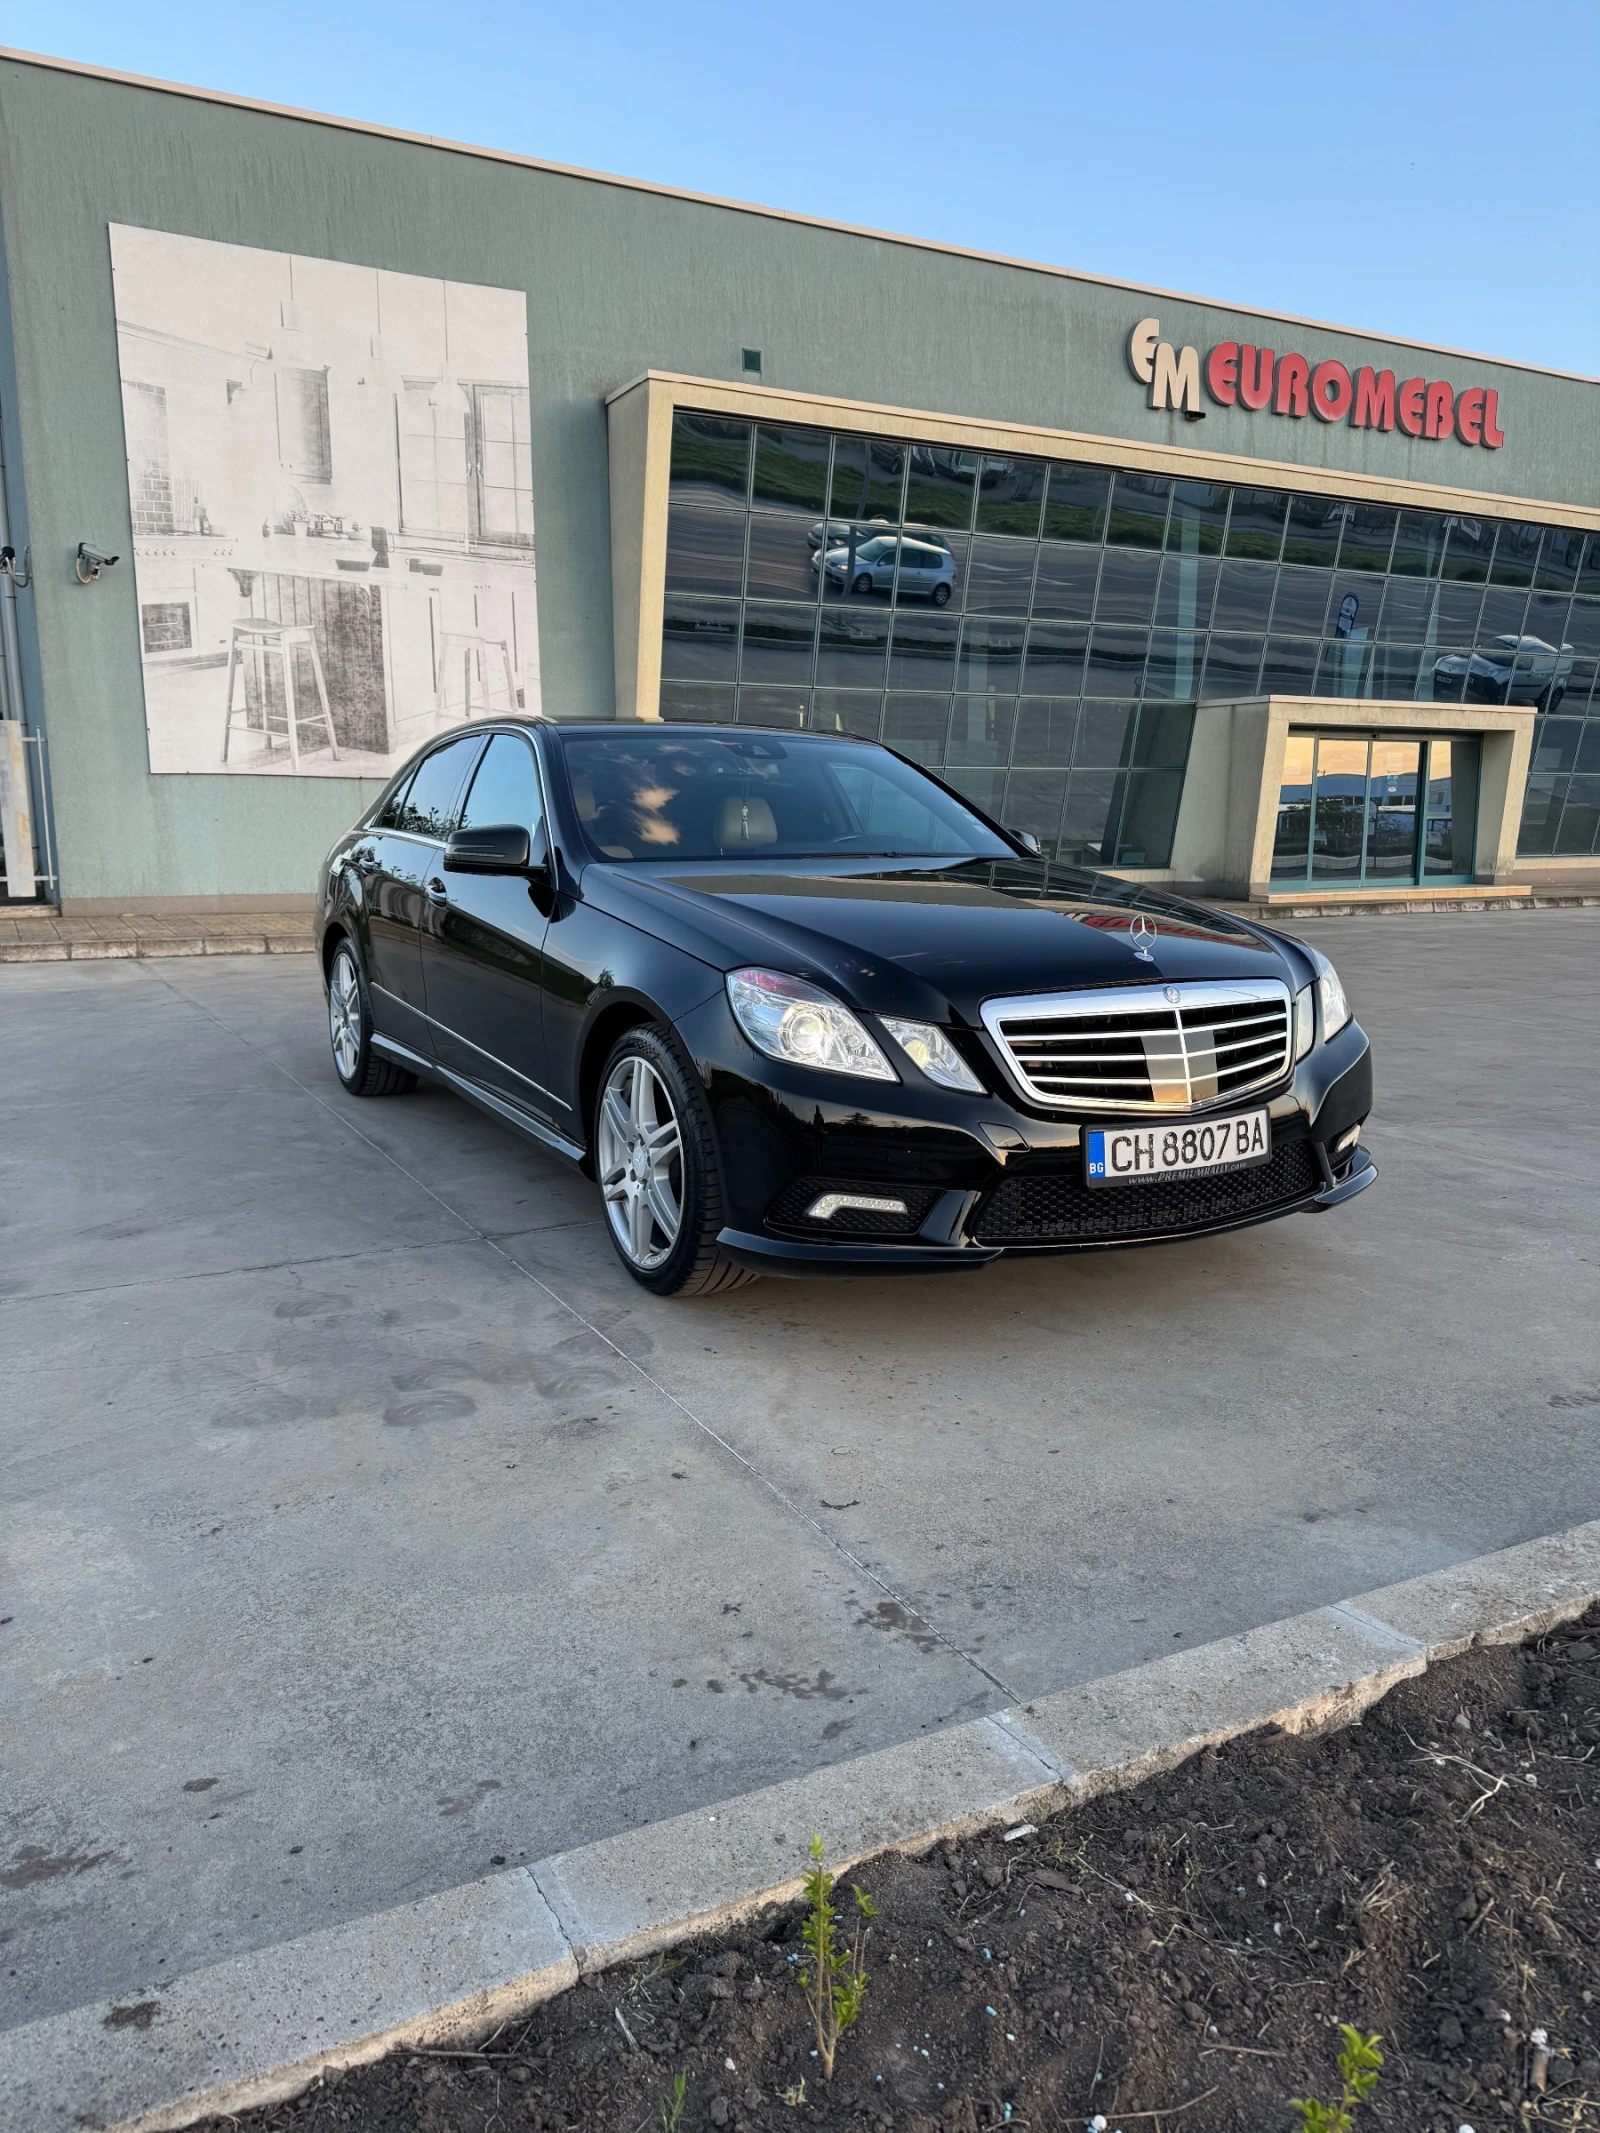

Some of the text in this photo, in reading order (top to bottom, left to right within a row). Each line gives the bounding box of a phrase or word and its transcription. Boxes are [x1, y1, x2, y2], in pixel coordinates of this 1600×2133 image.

[1205, 341, 1504, 449] EUROMEBEL
[1111, 1117, 1264, 1172] CH 8807 BA
[1089, 1162, 1104, 1174] BG
[1128, 1162, 1247, 1184] www.PREMIUMRALLY.com
